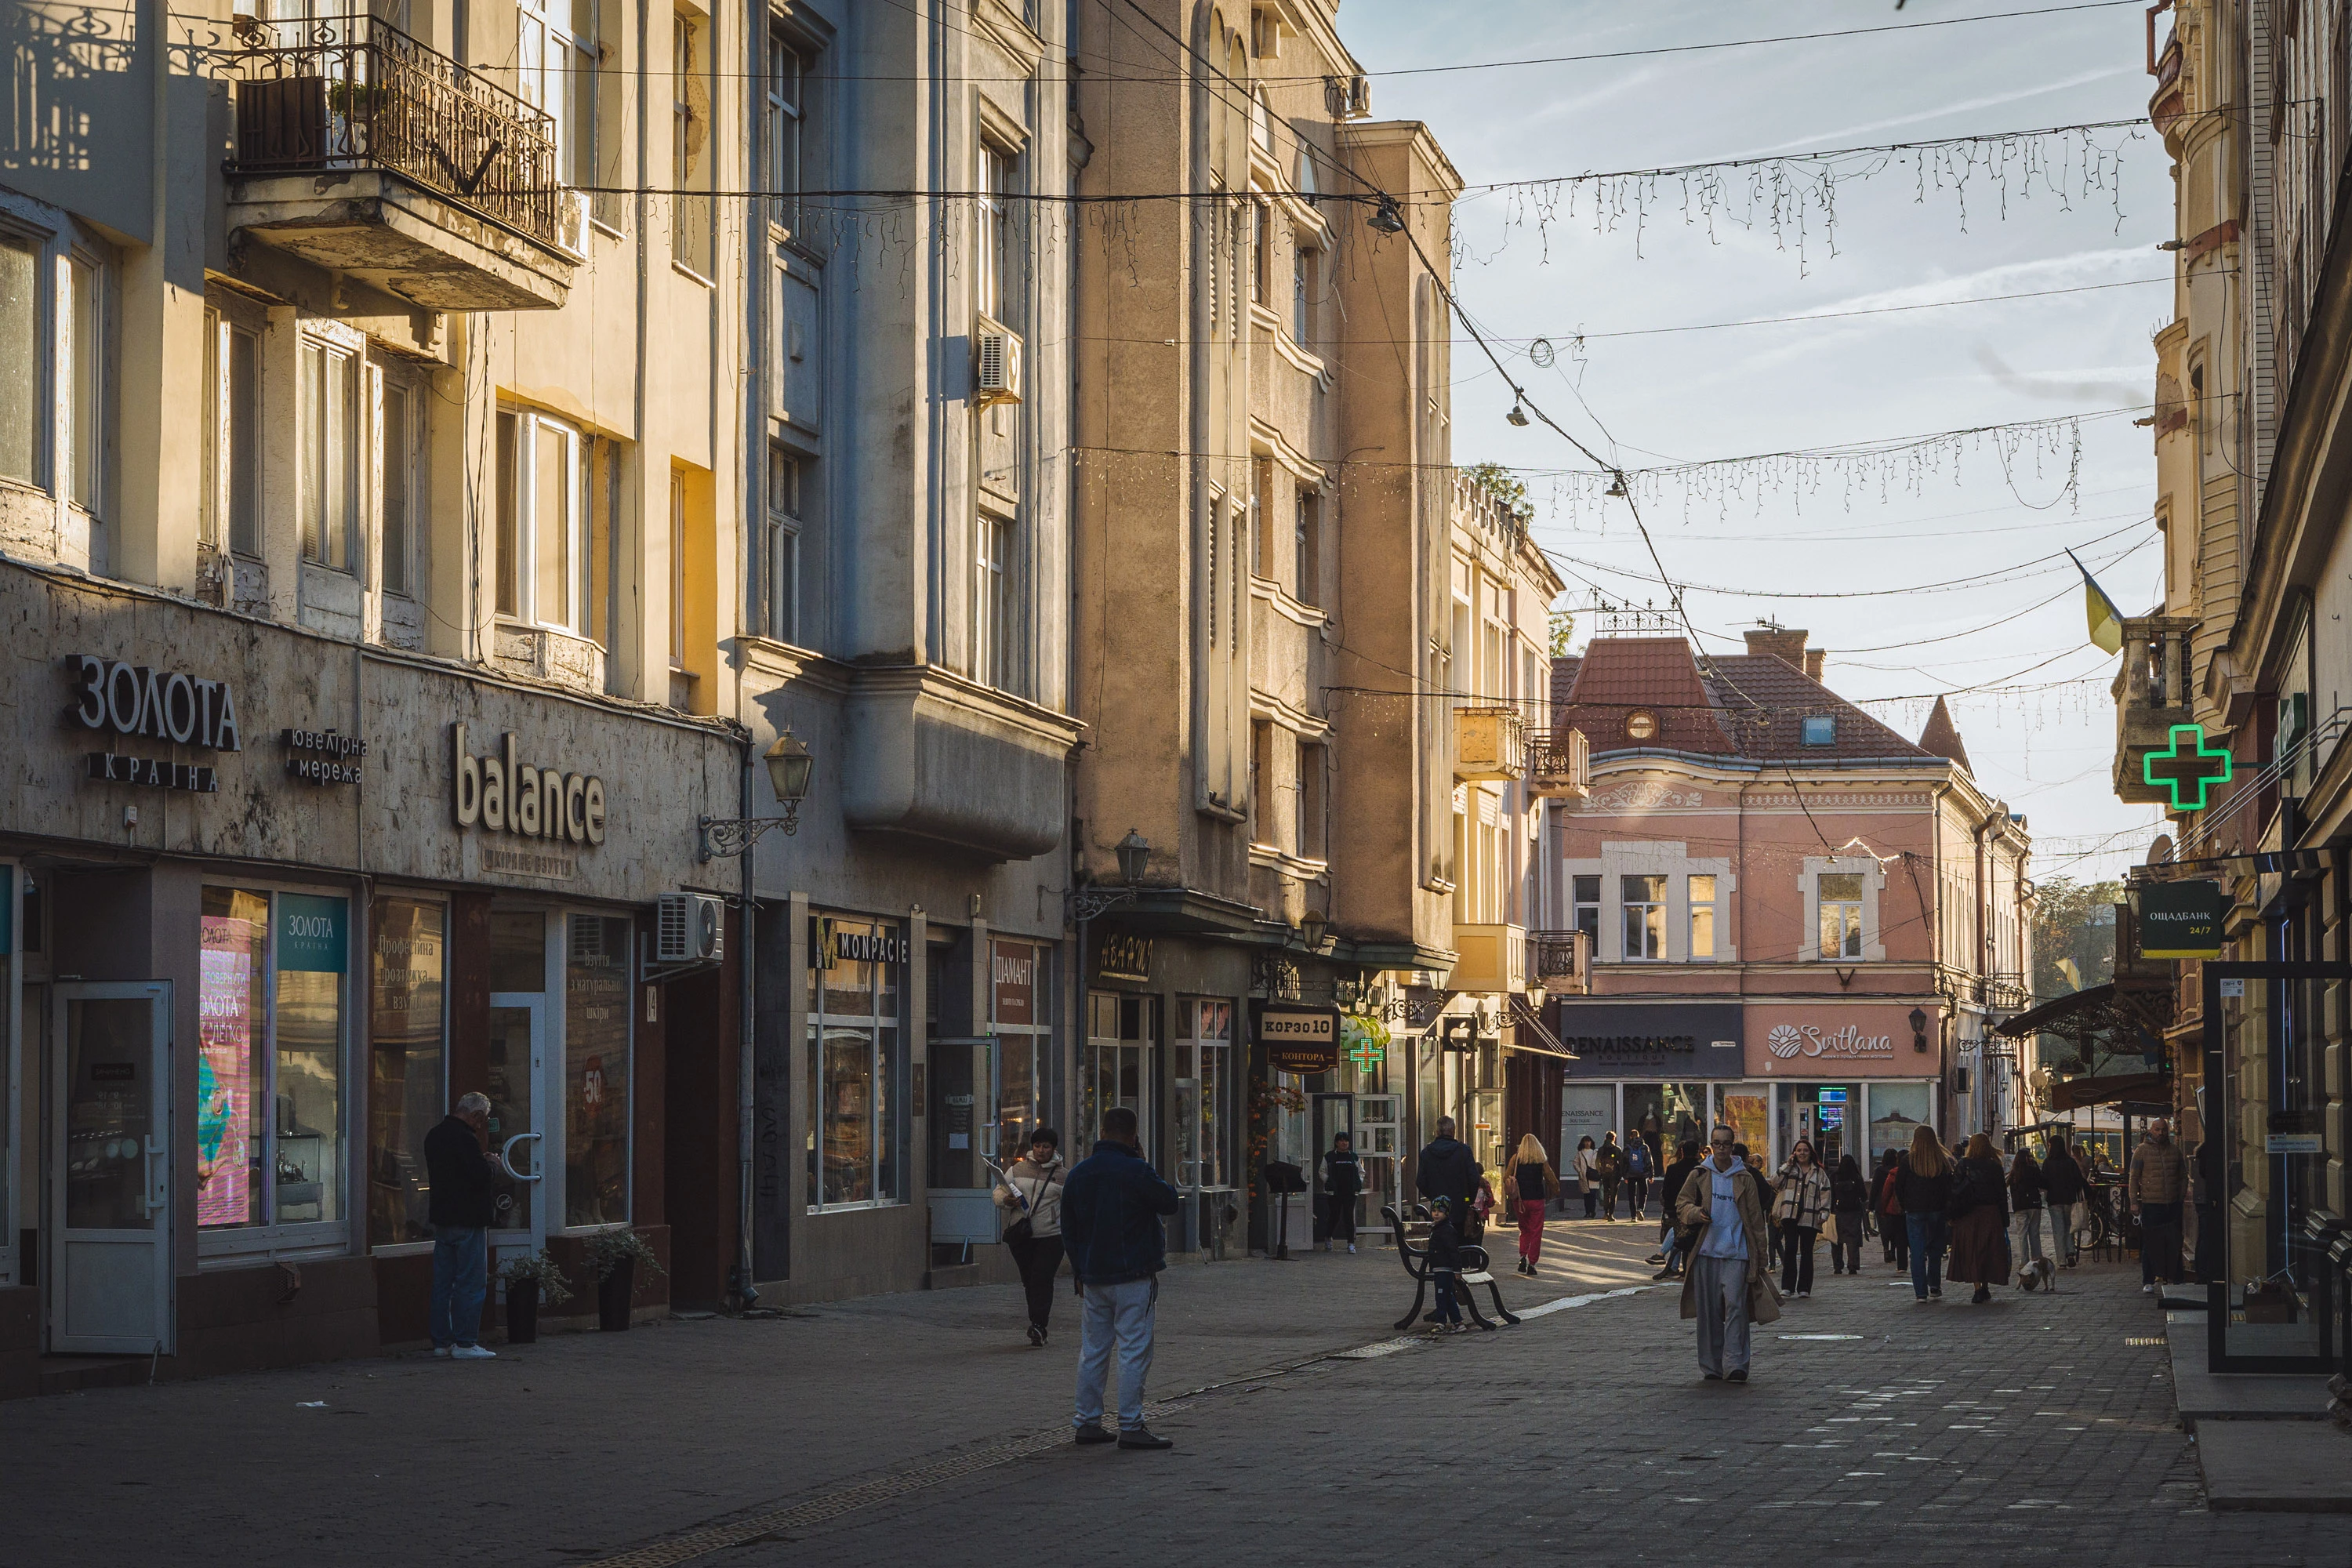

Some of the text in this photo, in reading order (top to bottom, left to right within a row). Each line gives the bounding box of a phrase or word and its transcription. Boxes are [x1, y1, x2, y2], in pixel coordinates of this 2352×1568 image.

[78, 654, 241, 751] ЗОЛОТА
[292, 729, 367, 757] ювелірна
[299, 759, 362, 786] мережа
[452, 721, 605, 846] balance
[289, 915, 333, 938] ЗОЛОТА
[2150, 912, 2211, 921] ОЩАДБАНК
[201, 927, 233, 944] ОЛОТА
[2190, 926, 2212, 935] 24/7
[841, 933, 907, 964] MONPACIE
[584, 949, 610, 971] Взуття
[996, 956, 1032, 987] ДІАМАНТ
[199, 996, 239, 1017] ОЛОТА
[586, 1004, 609, 1023] шкіри
[1265, 1020, 1330, 1033] КОРЗО 10
[1801, 1025, 1893, 1057] Svitlana
[1282, 1052, 1325, 1062] КОНТОРА
